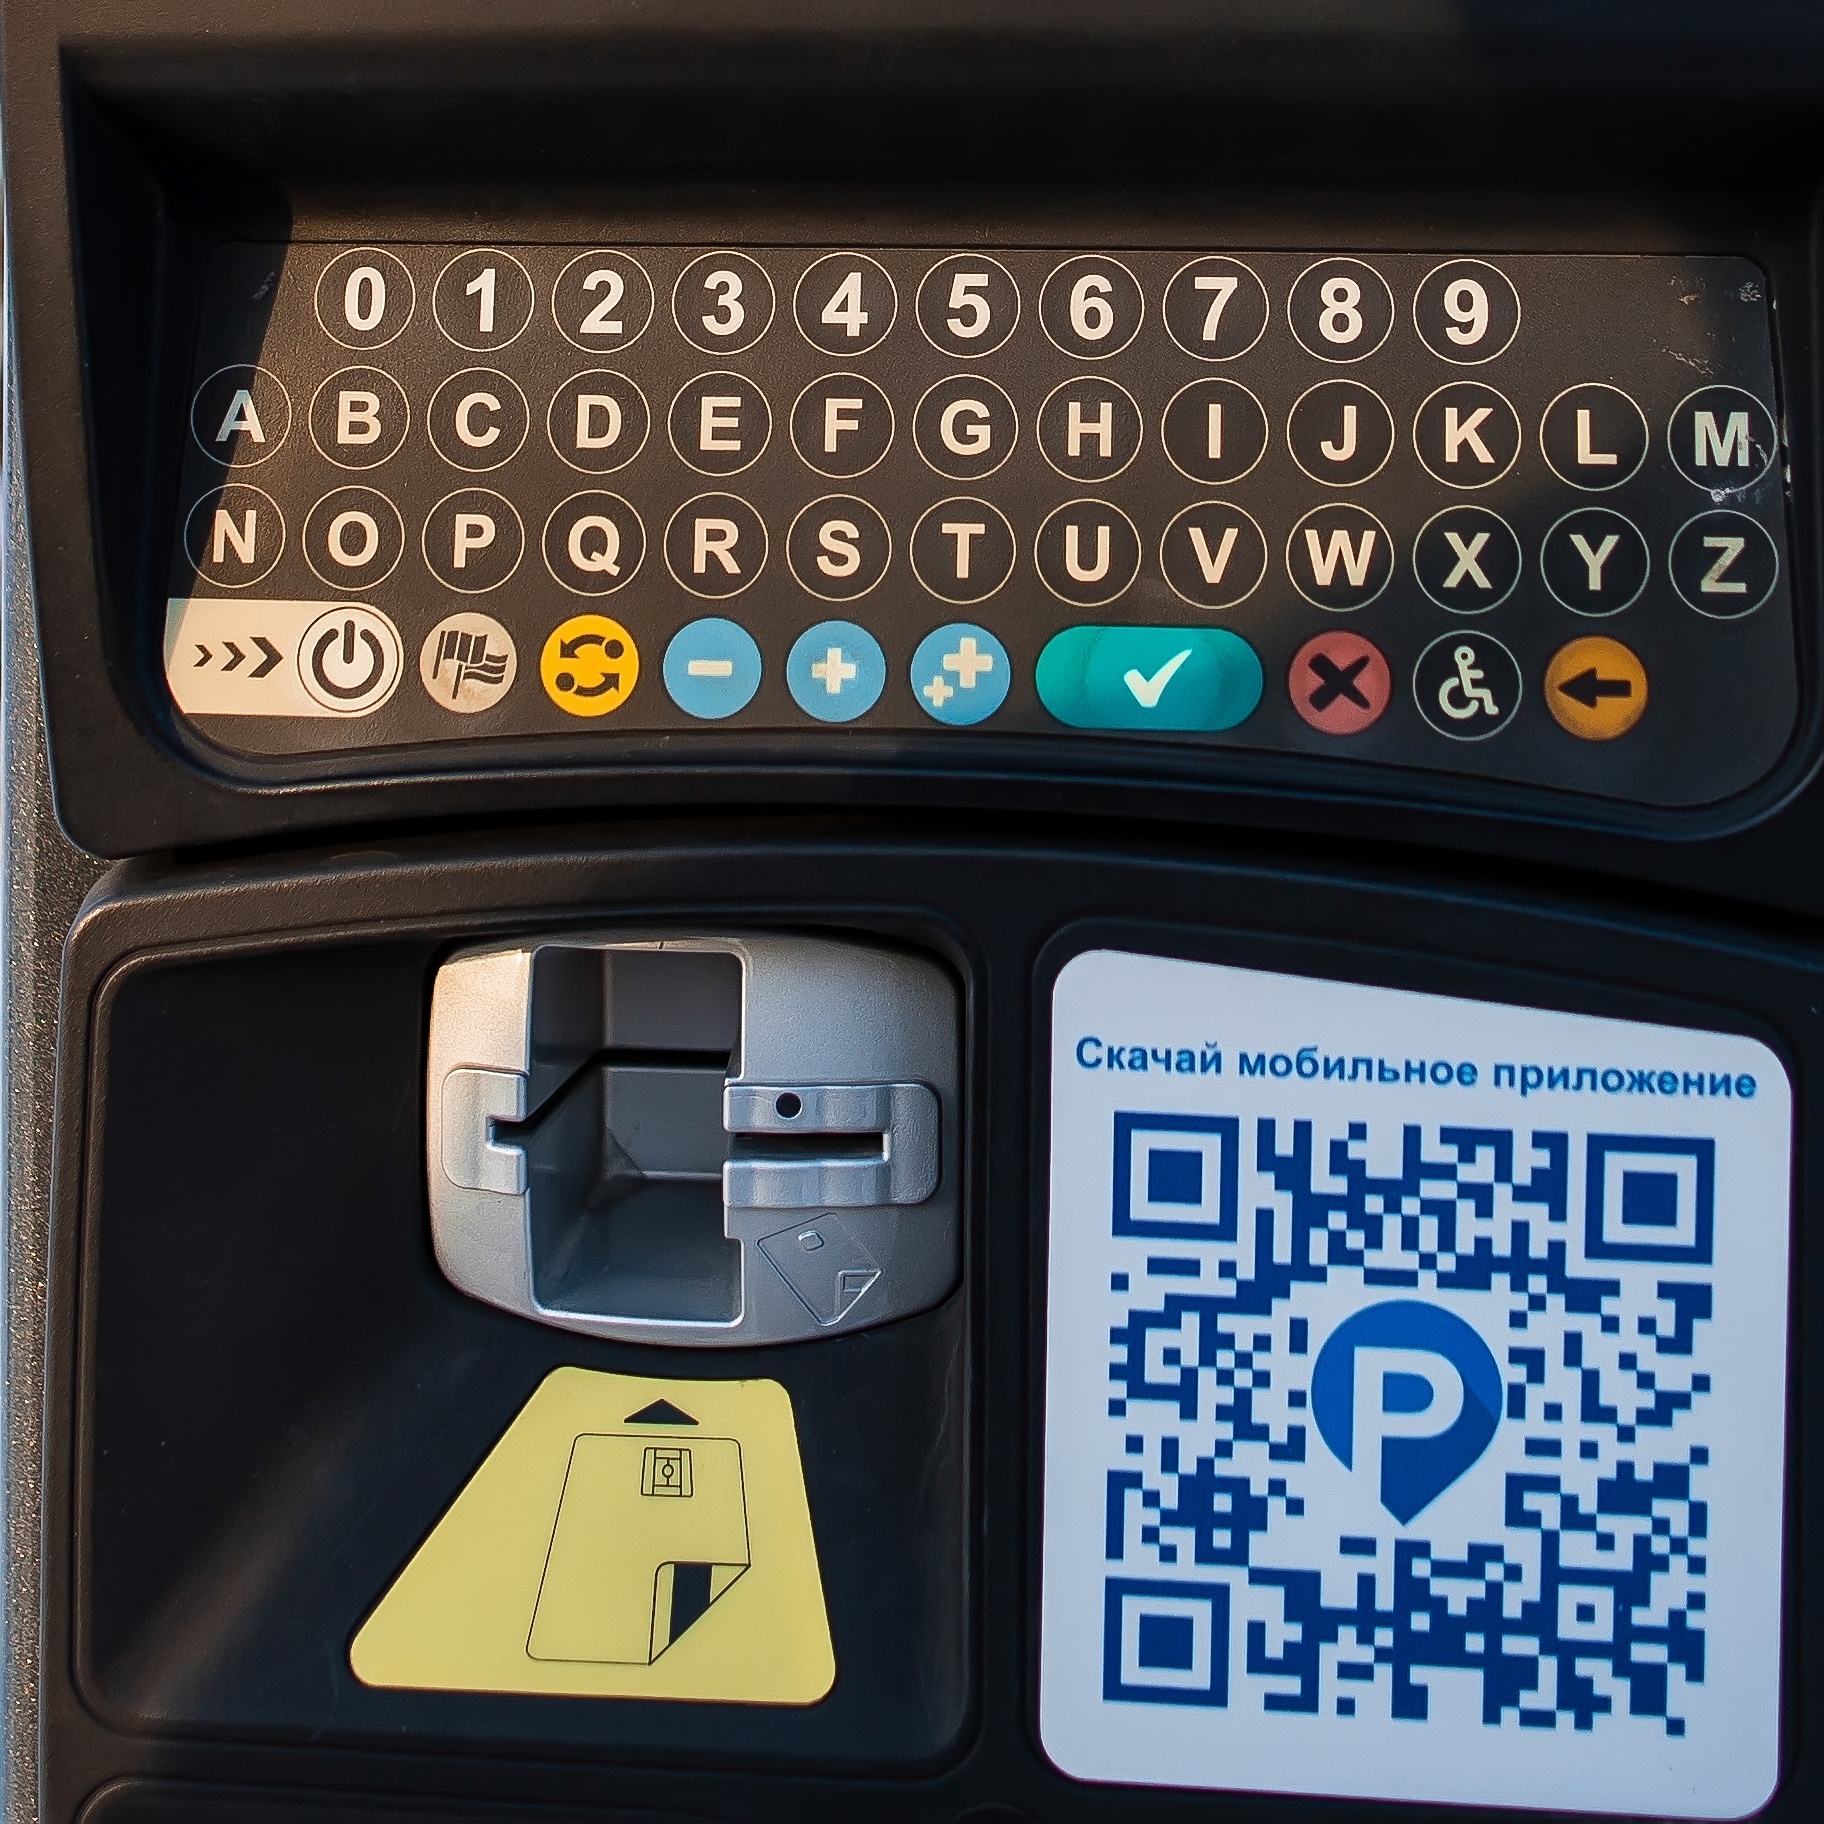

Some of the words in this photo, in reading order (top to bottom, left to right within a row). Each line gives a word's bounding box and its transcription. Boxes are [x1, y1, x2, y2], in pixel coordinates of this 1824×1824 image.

[343, 267, 385, 330] 0
[466, 269, 495, 332] 1
[580, 270, 624, 333] 2
[702, 271, 744, 335] 3
[822, 272, 868, 336] 4
[947, 274, 990, 338] 5
[1070, 275, 1113, 340] 6
[1195, 277, 1237, 340] 7
[1319, 278, 1362, 343] 8
[1444, 279, 1488, 345] 9
[216, 386, 270, 446] A
[334, 389, 385, 444] B
[456, 393, 501, 447] C
[576, 395, 621, 448] D
[700, 397, 741, 450] E
[825, 398, 862, 452] F
[941, 400, 990, 455] G
[1068, 402, 1112, 457] H
[1209, 404, 1221, 458] I
[1321, 406, 1356, 461] J
[1446, 408, 1494, 463] K
[1577, 410, 1617, 464] L
[1695, 411, 1753, 466] M
[209, 508, 260, 563] N
[328, 511, 378, 566] O
[454, 514, 495, 568] P
[568, 516, 620, 576] Q
[694, 518, 740, 573] R
[817, 520, 860, 577] S
[942, 523, 985, 578] T
[1066, 525, 1109, 581] U
[1189, 527, 1238, 583] V
[1305, 529, 1376, 585] W
[1443, 532, 1492, 588] X
[1570, 534, 1619, 590] Y
[1701, 537, 1746, 593] Z
[1075, 1036, 1224, 1079] Скачай
[1238, 1047, 1480, 1088] мобильное
[1494, 1058, 1759, 1100] приложение
